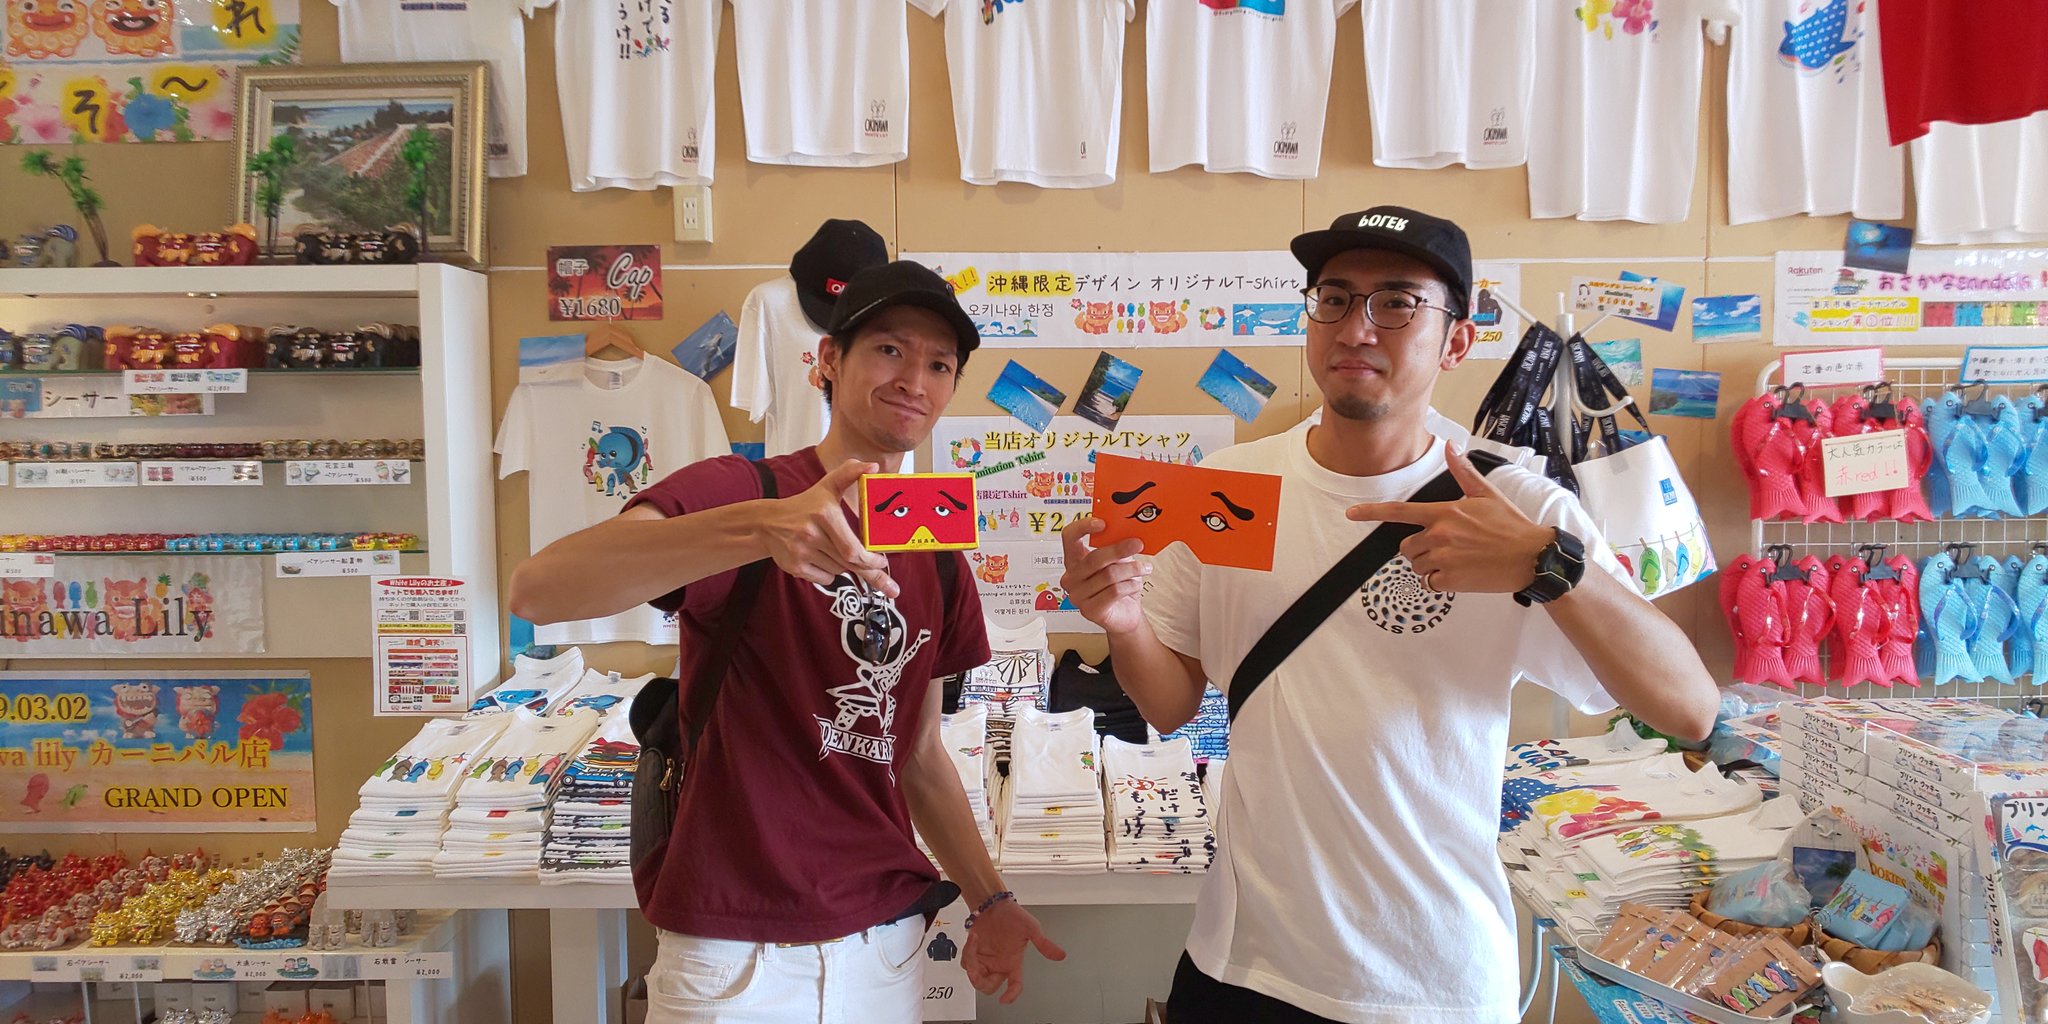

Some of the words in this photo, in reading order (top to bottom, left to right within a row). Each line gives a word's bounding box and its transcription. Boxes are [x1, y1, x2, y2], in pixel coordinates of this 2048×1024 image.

[559, 260, 588, 276] 帽子
[1787, 266, 1823, 275] Rakuten
[609, 254, 653, 299] Cap
[989, 274, 1140, 293] 沖縄限定デザイン
[560, 298, 620, 316] ¥1680
[968, 303, 1022, 318] 오키나와
[1027, 303, 1054, 318] 한정
[984, 431, 1191, 451] 当店オリジナルTシャツ
[132, 597, 213, 642] Lily
[1804, 712, 1821, 724] プリント
[1804, 732, 1821, 743] プリント
[35, 741, 77, 773] lily
[92, 740, 270, 769] カーニバル店
[1804, 752, 1821, 763] プリント
[1899, 747, 1918, 759] プリント
[1900, 771, 1919, 784] プリント
[104, 787, 203, 808] GRAND
[211, 787, 289, 808] OPEN
[1896, 793, 1915, 806] プリント
[404, 957, 427, 966] シーサー
[416, 968, 441, 977] ¥2,000
